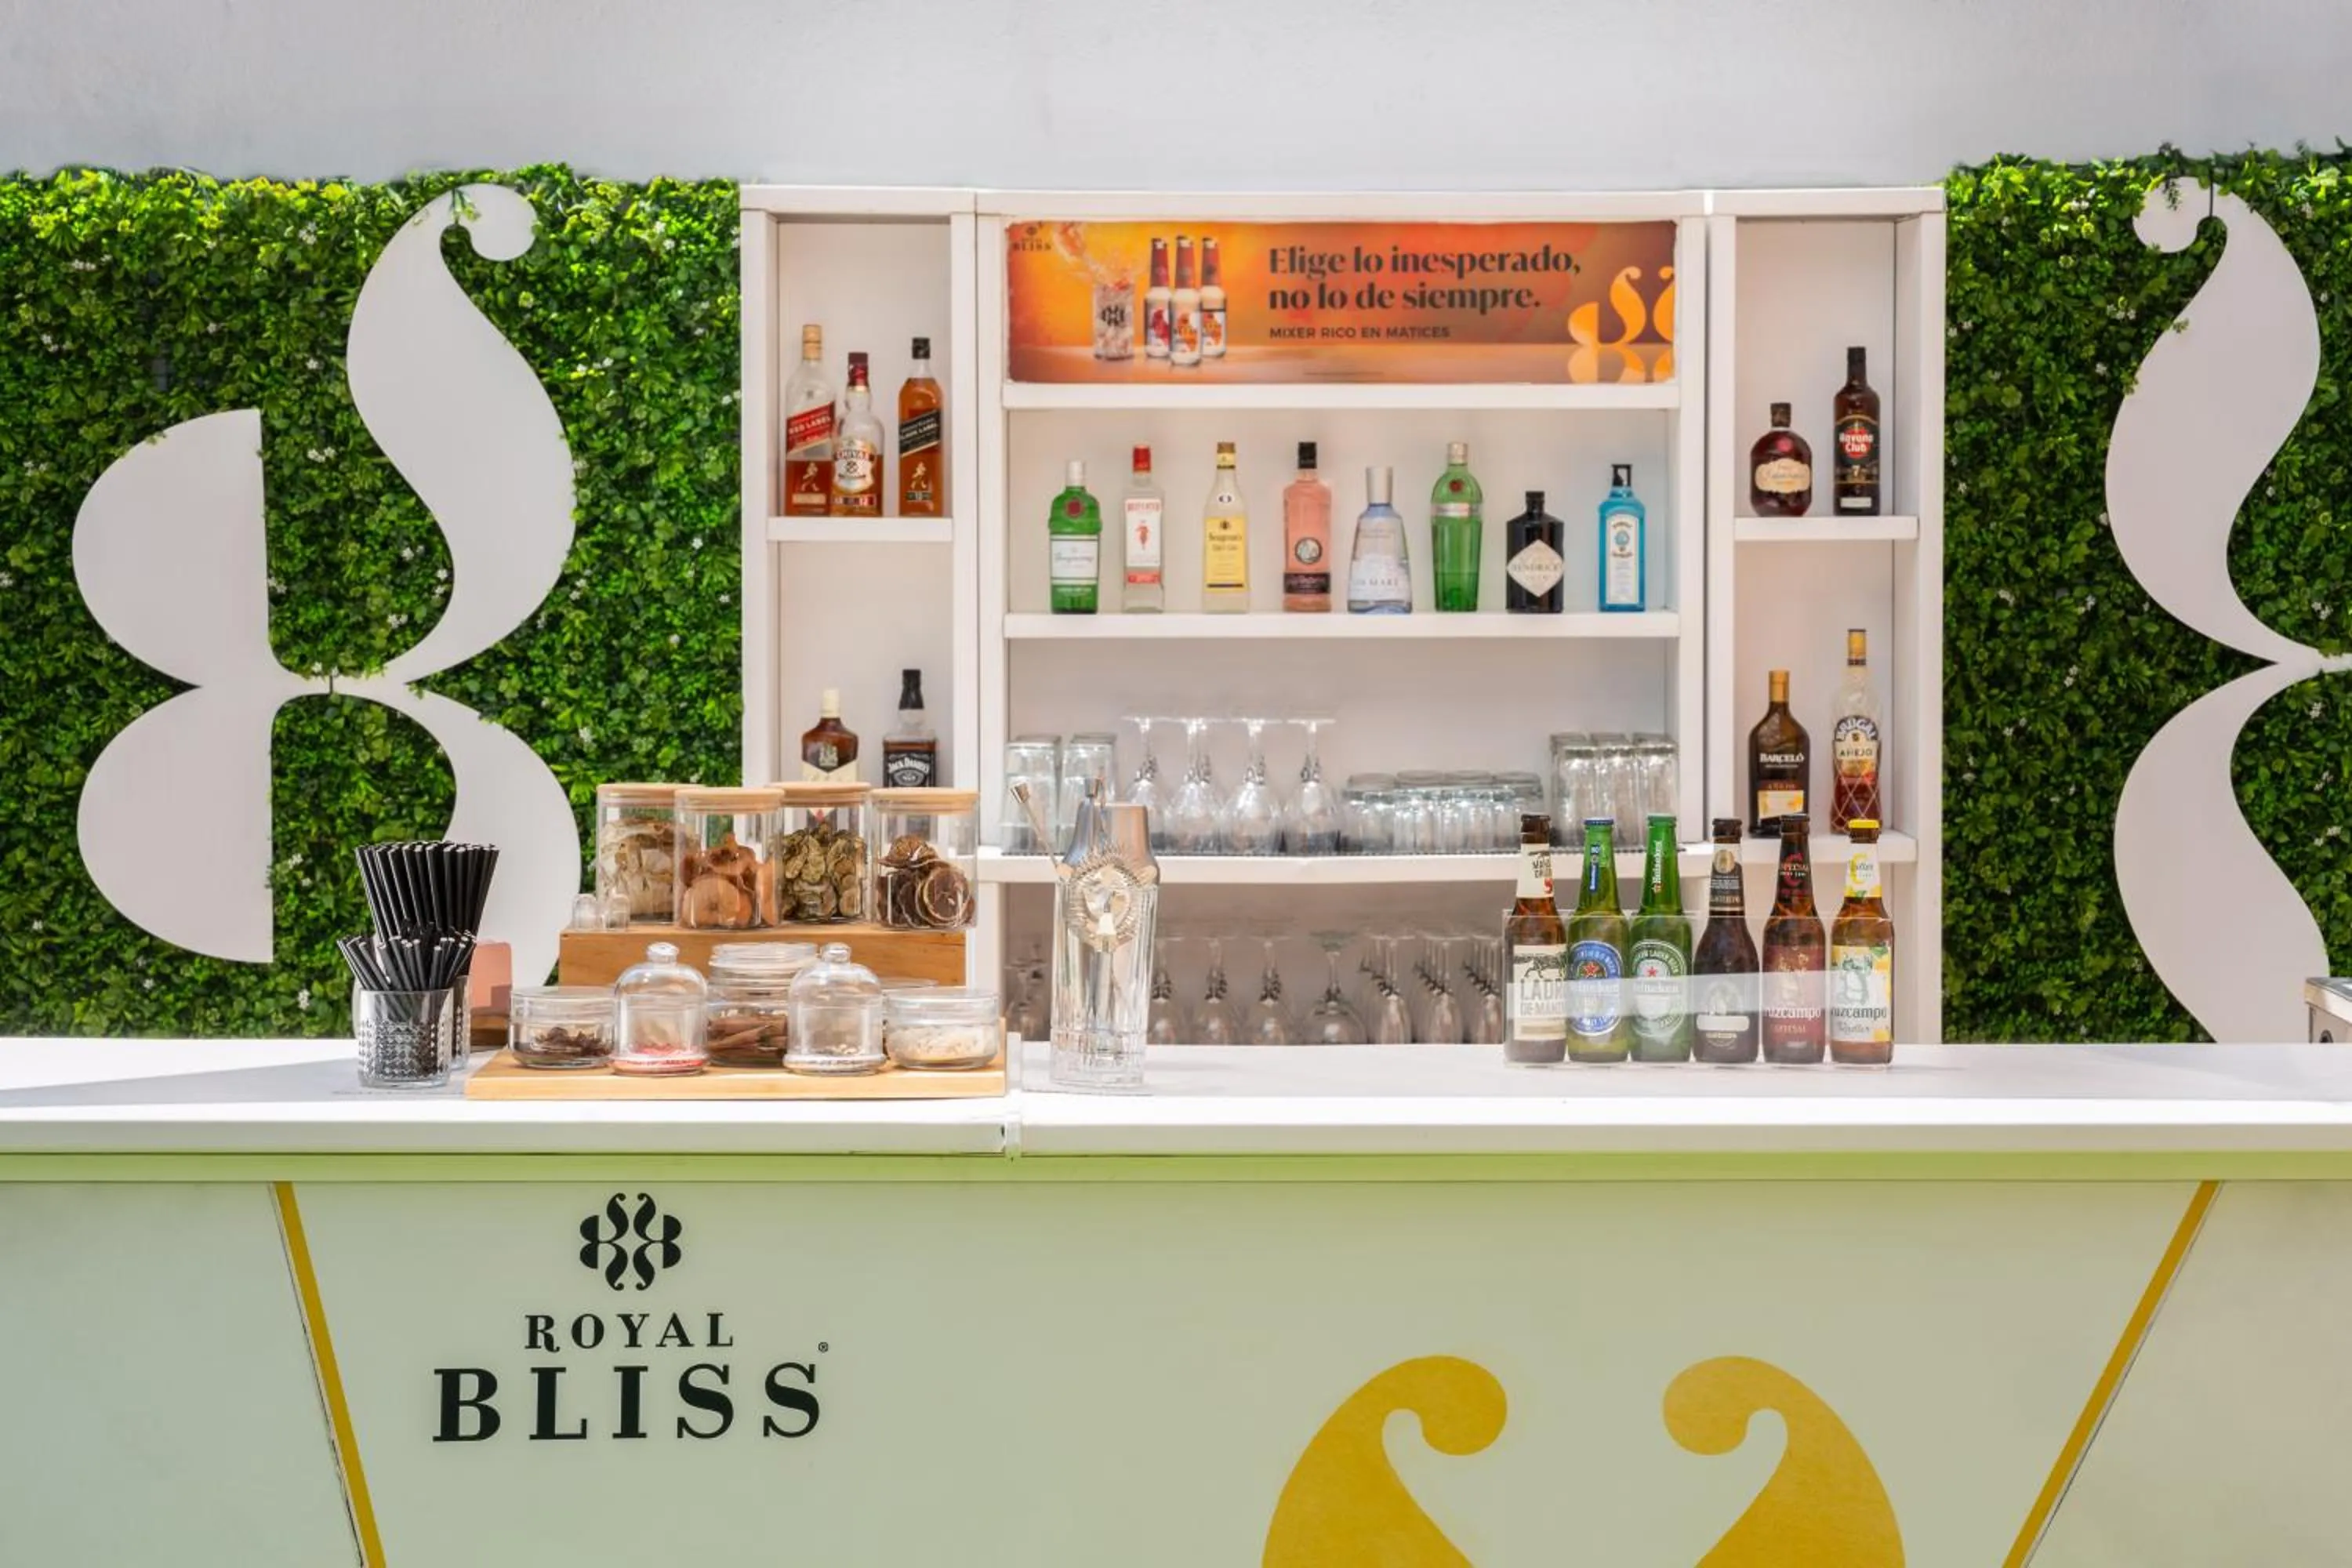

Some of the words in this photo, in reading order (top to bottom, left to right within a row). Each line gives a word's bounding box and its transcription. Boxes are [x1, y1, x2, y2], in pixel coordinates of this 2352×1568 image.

[1269, 246, 1345, 280] Elige
[1354, 246, 1383, 273] lo
[1392, 245, 1581, 278] inesperado,
[1269, 289, 1311, 310] no
[1318, 282, 1348, 310] lo
[1356, 282, 1395, 310] de
[1403, 281, 1541, 314] siempre.
[1269, 326, 1316, 339] MIXER
[1321, 326, 1356, 339] RICO
[1361, 326, 1381, 338] EN
[1386, 325, 1450, 338] MATICES
[1845, 442, 1867, 452] Club
[1521, 978, 1566, 1000] LADR
[524, 1312, 734, 1352] ROYAL
[432, 1362, 820, 1442] BLISS
